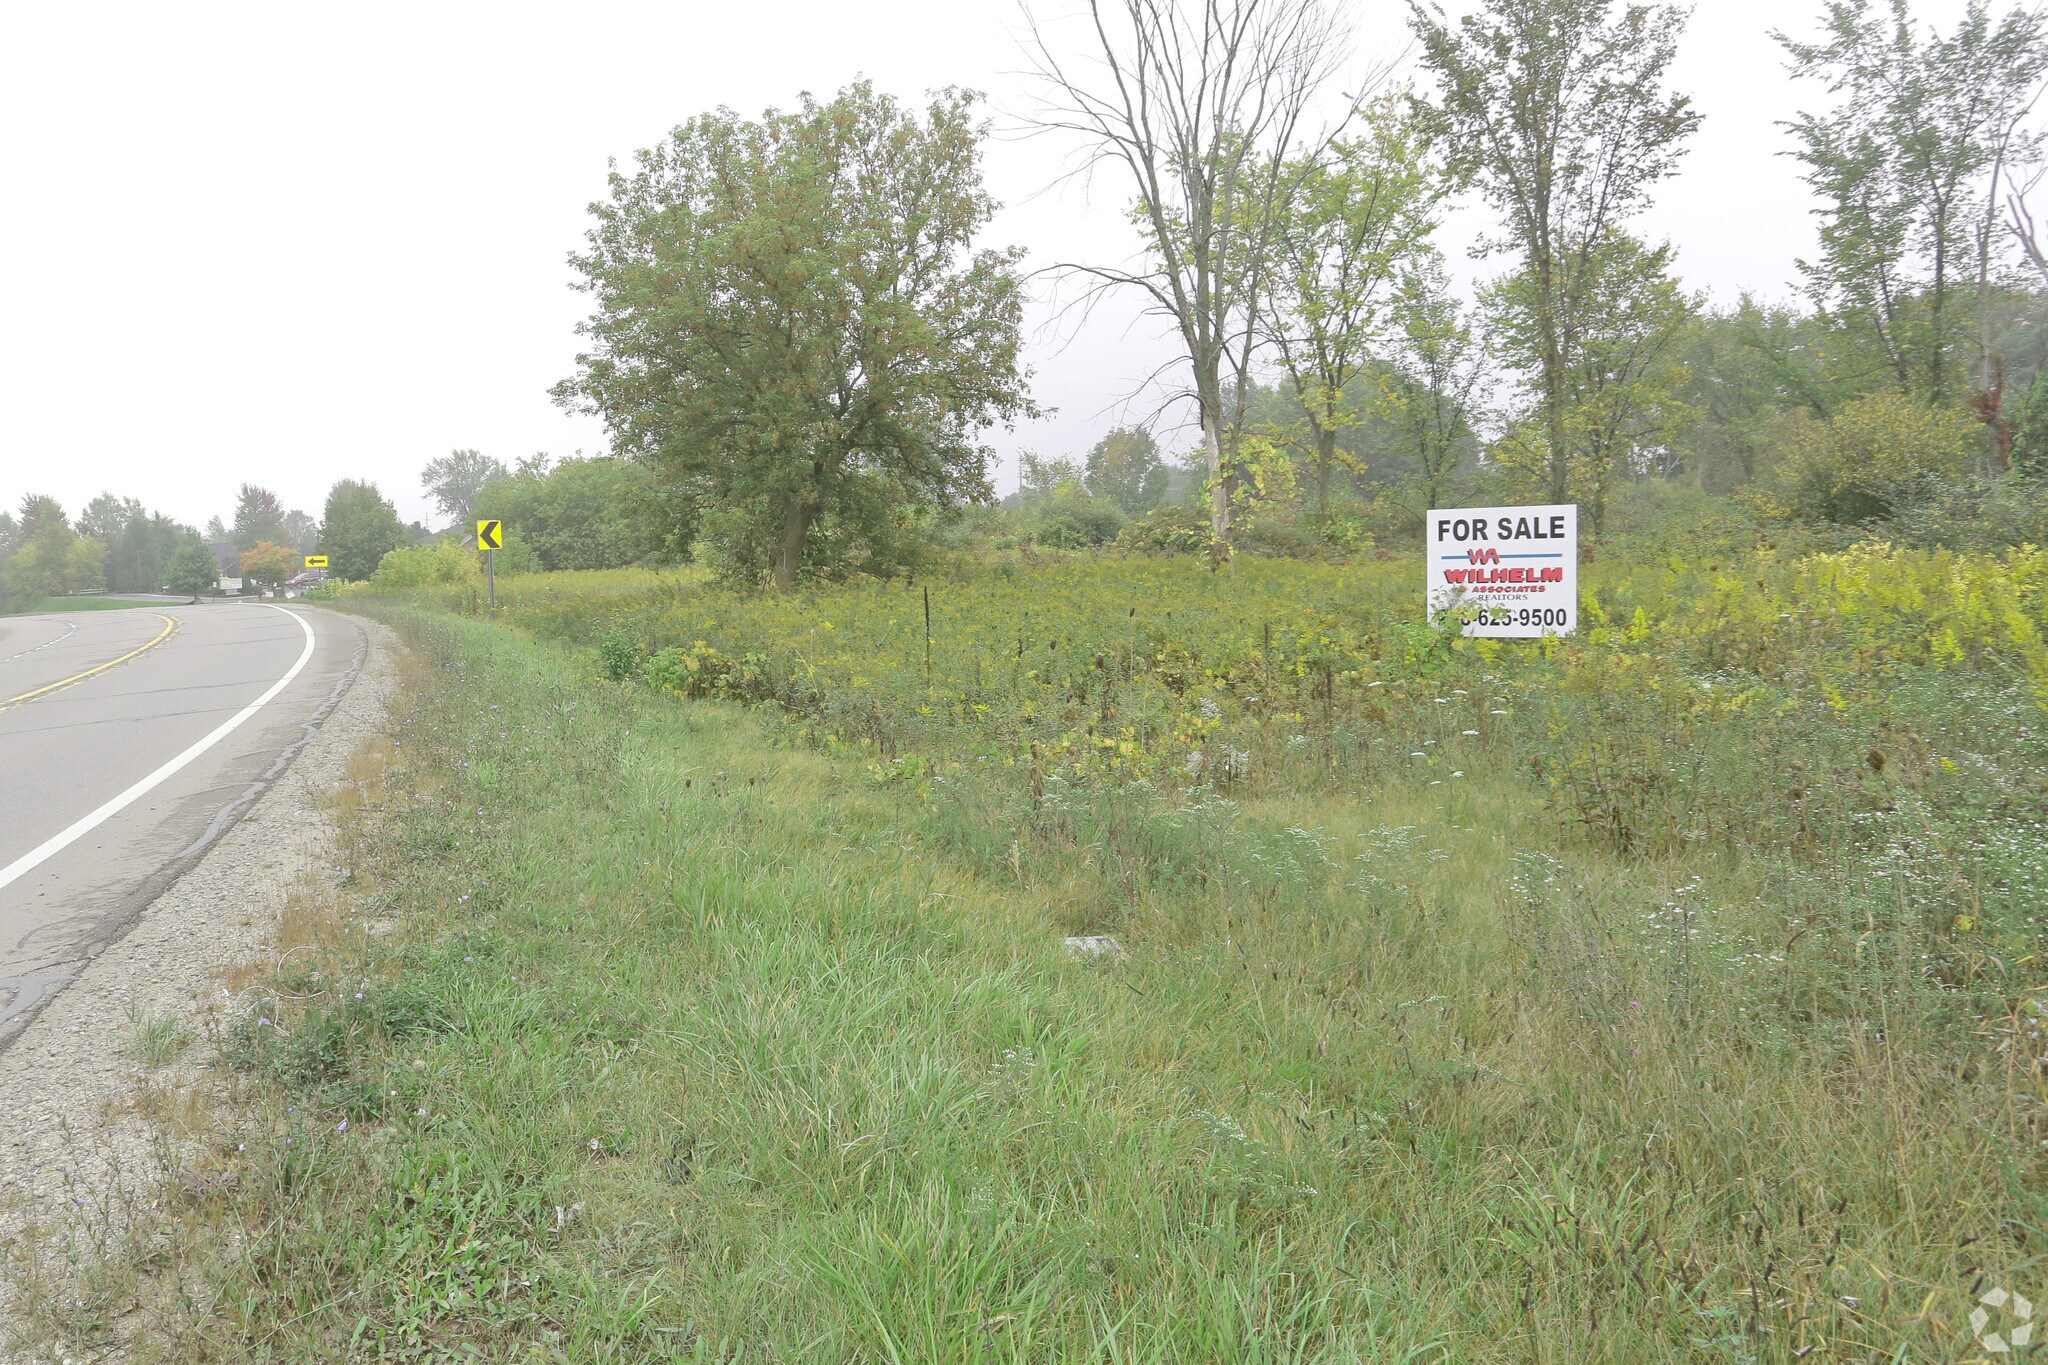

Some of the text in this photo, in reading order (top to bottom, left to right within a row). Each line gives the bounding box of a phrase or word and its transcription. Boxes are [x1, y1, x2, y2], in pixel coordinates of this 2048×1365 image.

[1438, 516, 1565, 542] FOR SALE
[1467, 548, 1500, 565] WA
[1444, 567, 1563, 584] WILHELM
[1472, 585, 1546, 593] ASSOCIATES
